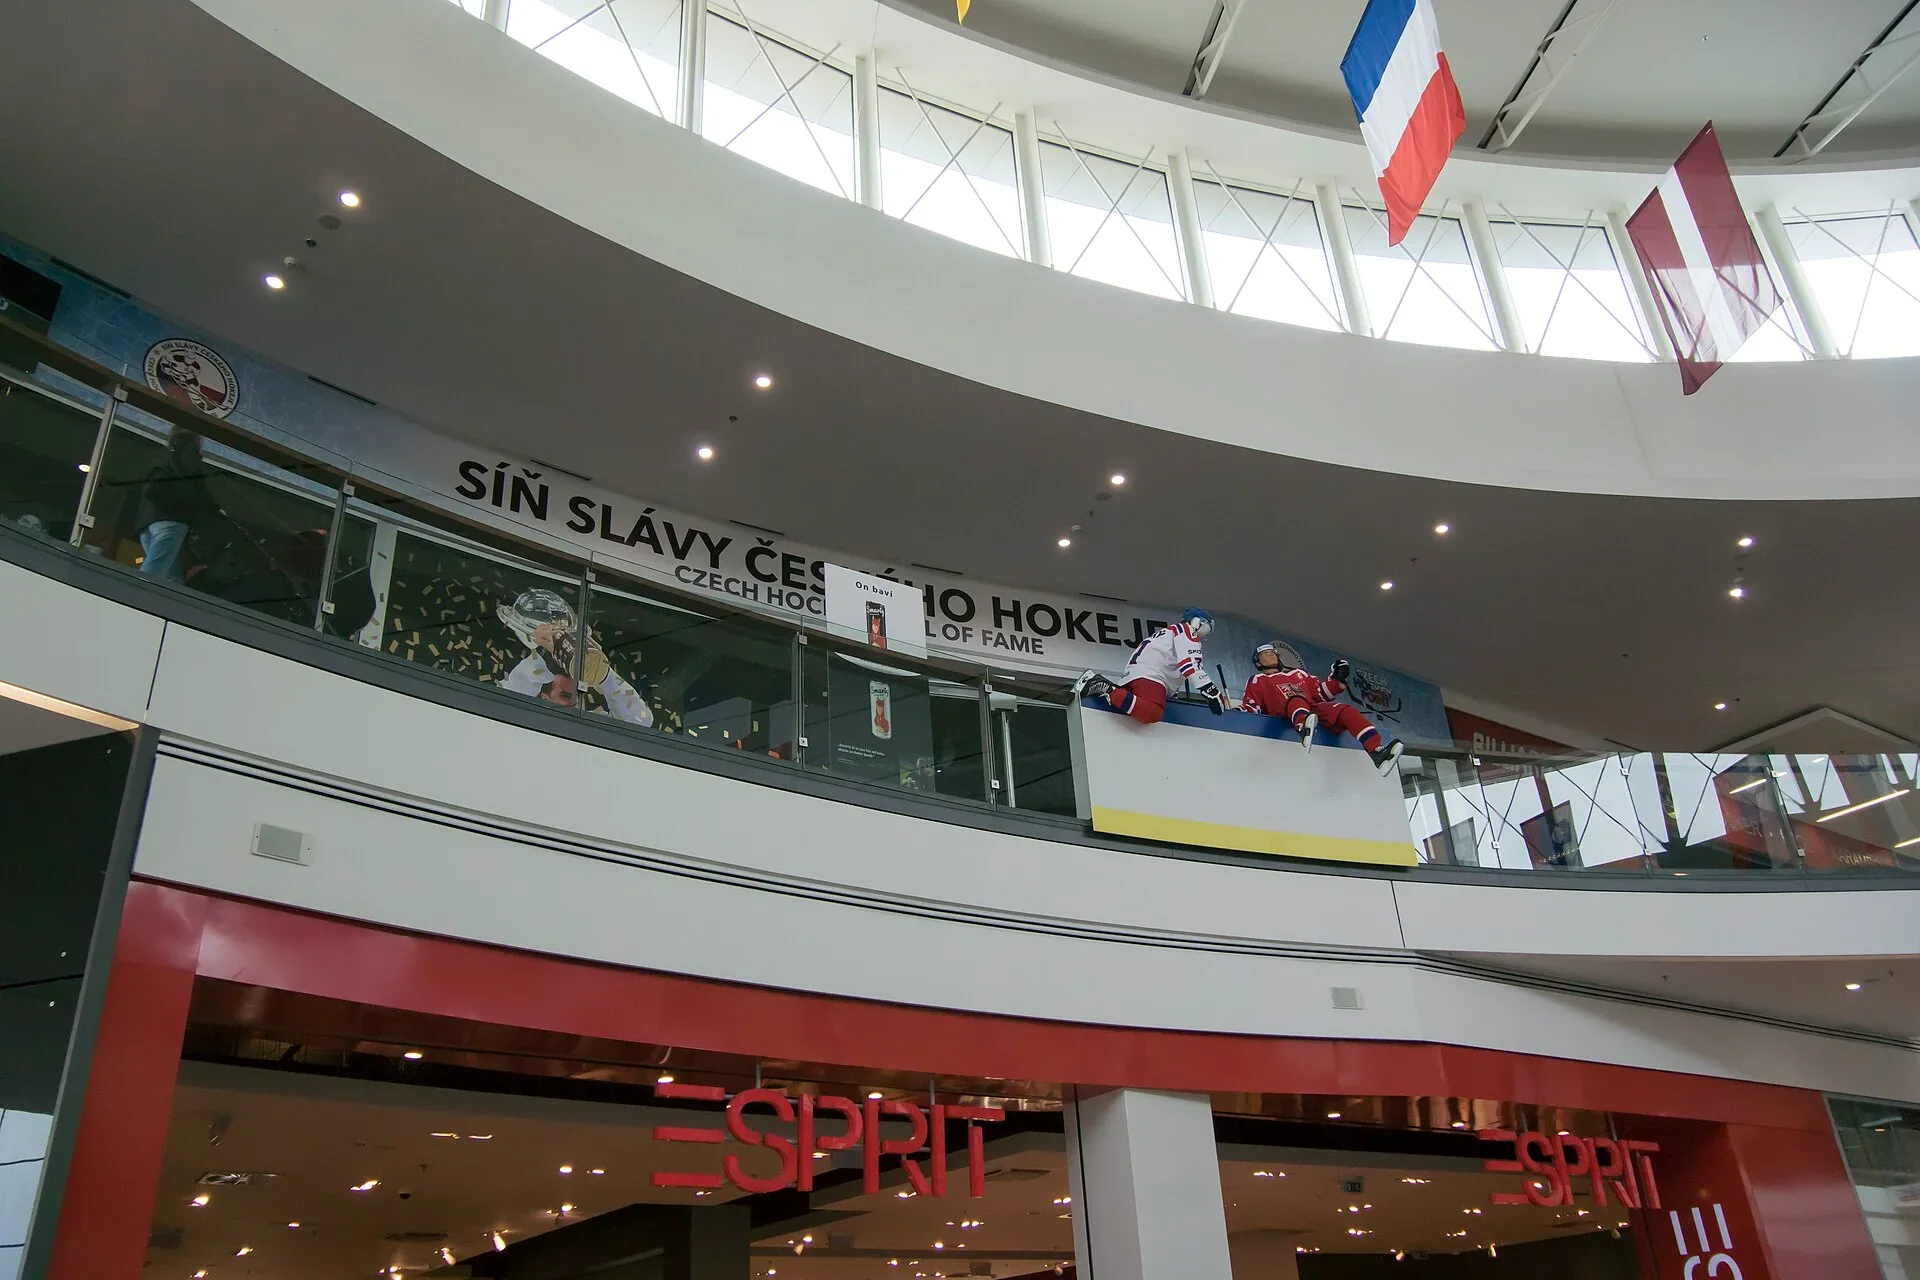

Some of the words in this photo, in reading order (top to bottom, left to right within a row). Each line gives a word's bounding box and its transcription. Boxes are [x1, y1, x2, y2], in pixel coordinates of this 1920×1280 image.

[454, 460, 549, 521] SÍŇ
[565, 496, 733, 569] SLÁVY
[744, 536, 977, 624] ČESHO
[855, 581, 869, 591] On
[674, 564, 759, 602] CZECH
[941, 622, 974, 643] OF
[981, 629, 1045, 656] FAME
[650, 1083, 1006, 1199] ESPRIT
[1478, 1128, 1662, 1209] ESPRIT
